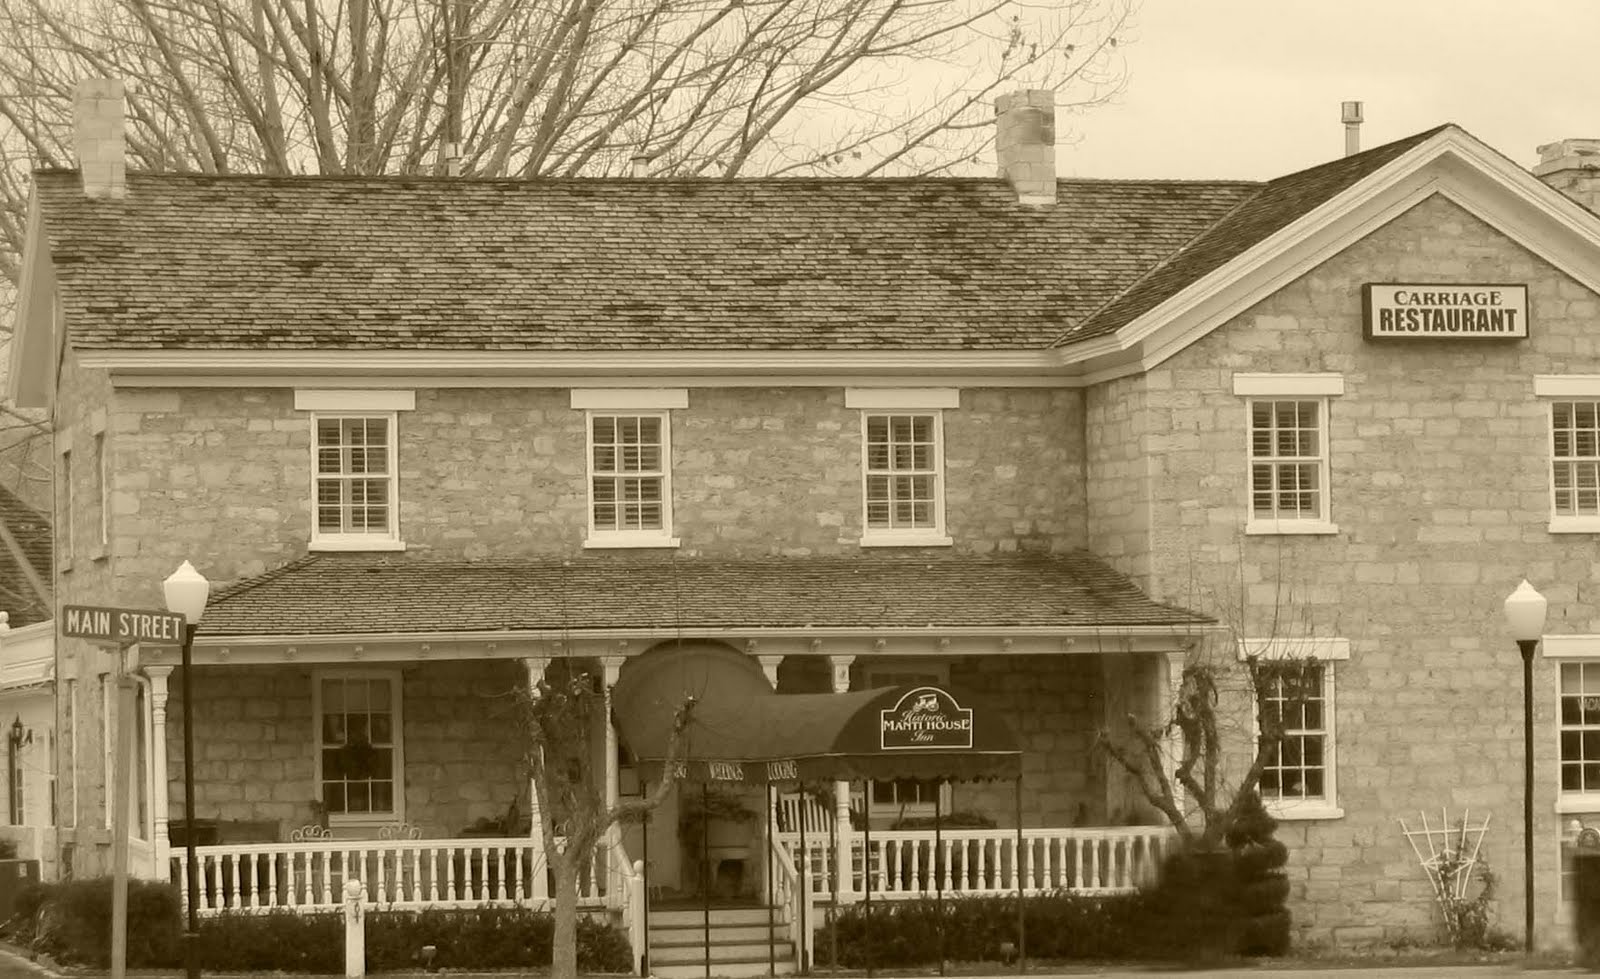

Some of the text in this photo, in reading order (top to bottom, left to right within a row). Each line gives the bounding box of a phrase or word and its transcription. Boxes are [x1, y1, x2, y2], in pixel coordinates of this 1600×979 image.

[1394, 291, 1503, 306] CARRIAGE
[1380, 308, 1518, 332] RESTAURANT
[68, 610, 182, 640] MAIN STREET
[883, 719, 970, 731] MANTI HOUSE
